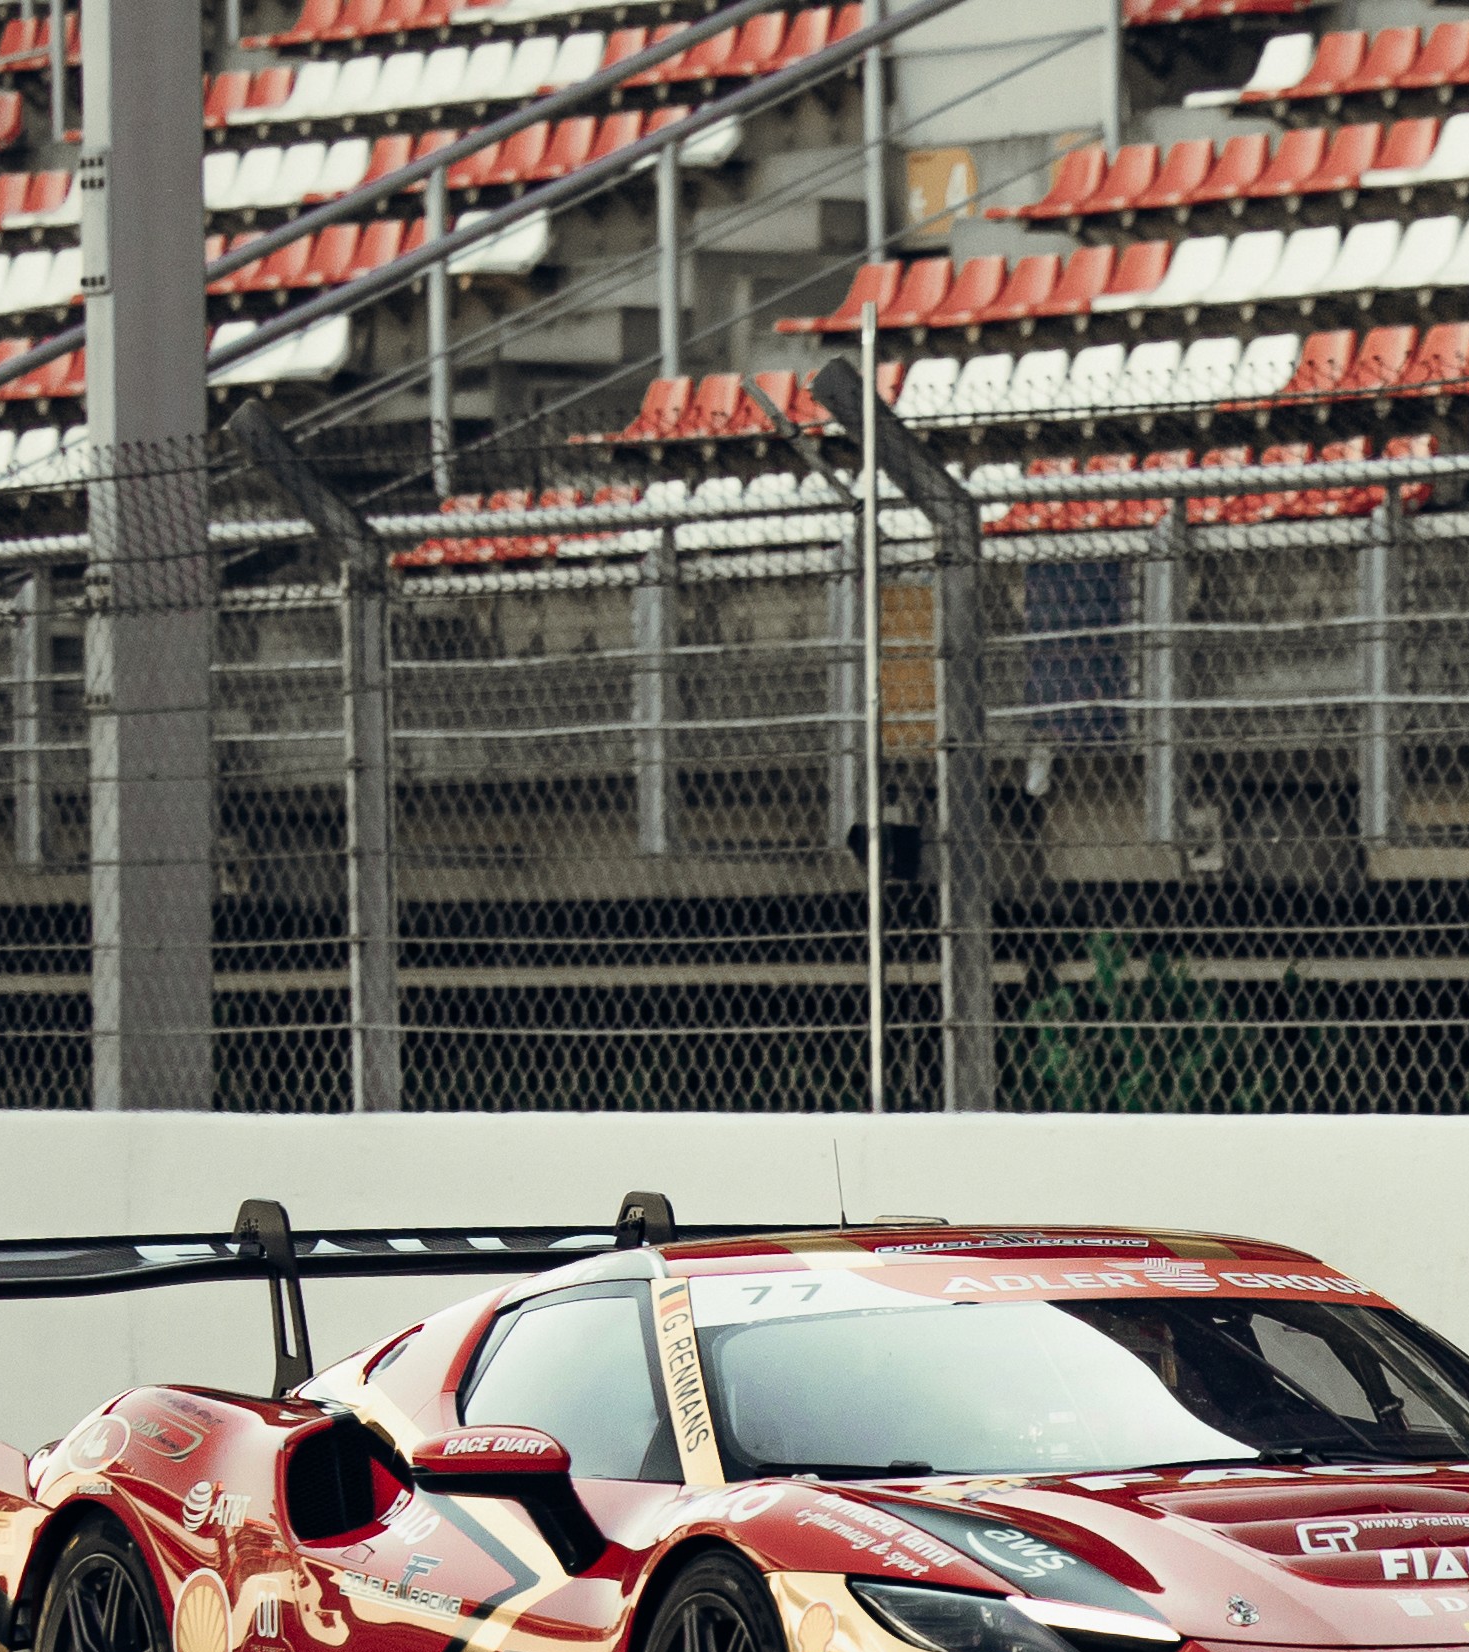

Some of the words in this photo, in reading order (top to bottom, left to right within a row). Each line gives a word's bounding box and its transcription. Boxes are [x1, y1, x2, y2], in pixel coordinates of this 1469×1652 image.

[1032, 1237, 1149, 1248] RACING
[942, 1271, 1141, 1295] ADLER
[1228, 1271, 1368, 1297] GROUP
[663, 1313, 689, 1340] G.
[667, 1336, 710, 1454] RENMANS
[443, 1437, 494, 1455] RACE
[492, 1437, 552, 1456] DIARY
[796, 1508, 877, 1550] e-pharmacy
[869, 1541, 887, 1555] &
[882, 1547, 930, 1576] sport
[814, 1494, 904, 1537] farmacia
[898, 1532, 960, 1567] ianni
[1295, 1520, 1361, 1555] GR
[984, 1528, 1077, 1570] aws
[410, 1586, 462, 1614] RACING
